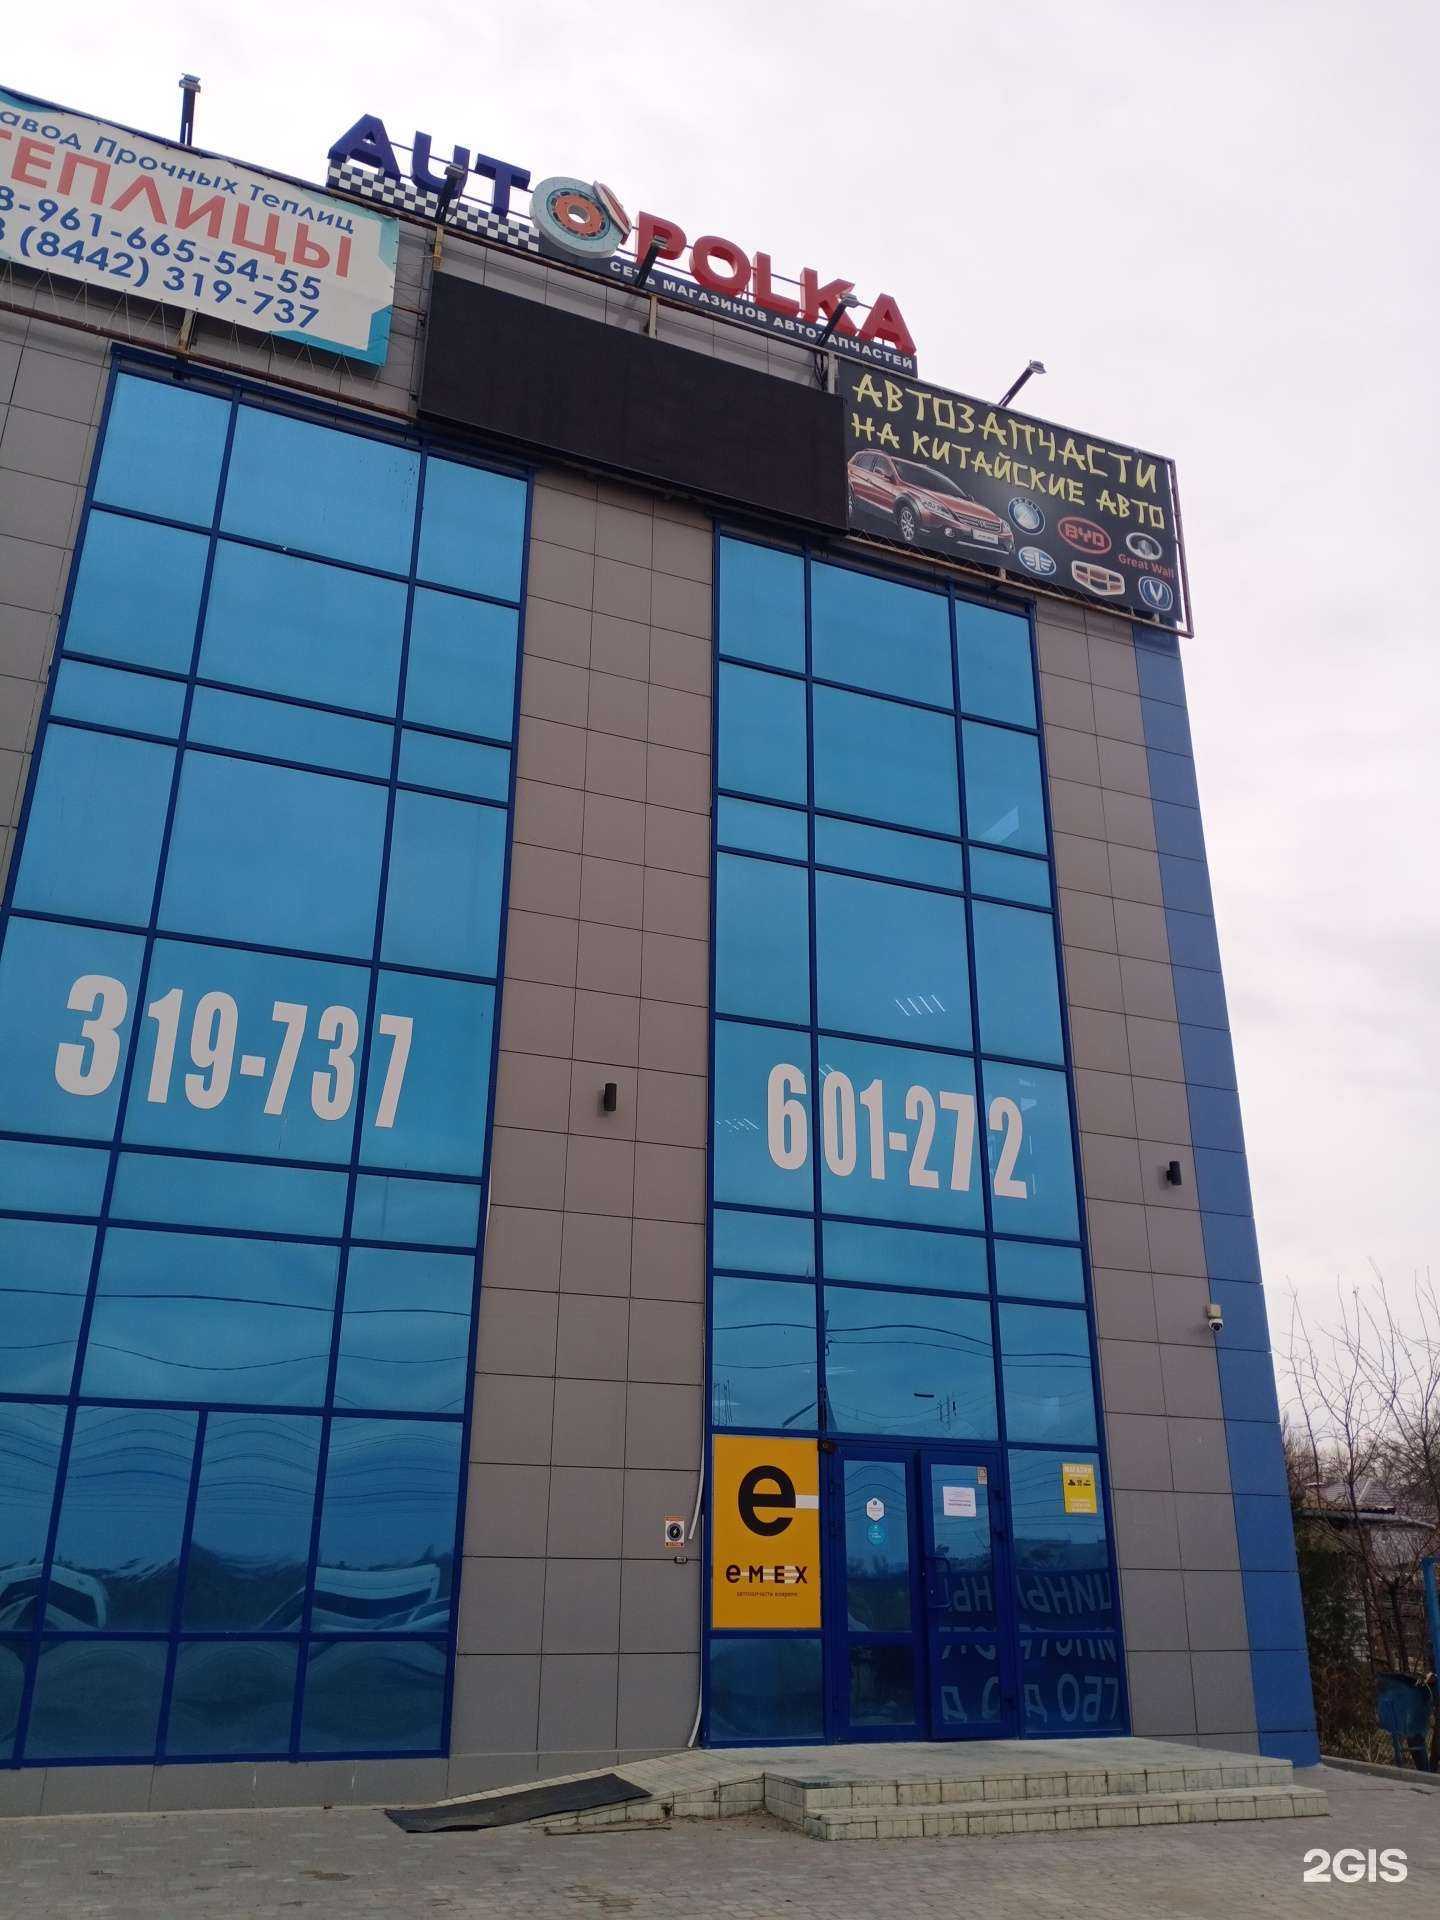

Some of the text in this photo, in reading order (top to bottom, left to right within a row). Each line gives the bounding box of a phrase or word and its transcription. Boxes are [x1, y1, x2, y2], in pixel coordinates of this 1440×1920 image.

[93, 136, 238, 195] Прочных
[250, 183, 354, 235] Теплиц
[0, 185, 322, 300] 8-961-665-54-55
[20, 226, 320, 328] (8442) 319-737
[663, 279, 768, 323] МАГАЗИНОВ
[773, 316, 913, 370] АВТОАПЧАСТЕЙ
[851, 373, 1158, 493] АВТОЗАПЧАСТИ
[851, 413, 1166, 530] НА КИТАЙСКИЕ АВТО
[1064, 522, 1106, 549] BYD
[1118, 553, 1175, 579] Great Wall
[54, 974, 414, 1129] 319-737
[767, 1063, 1028, 1199] 601-272
